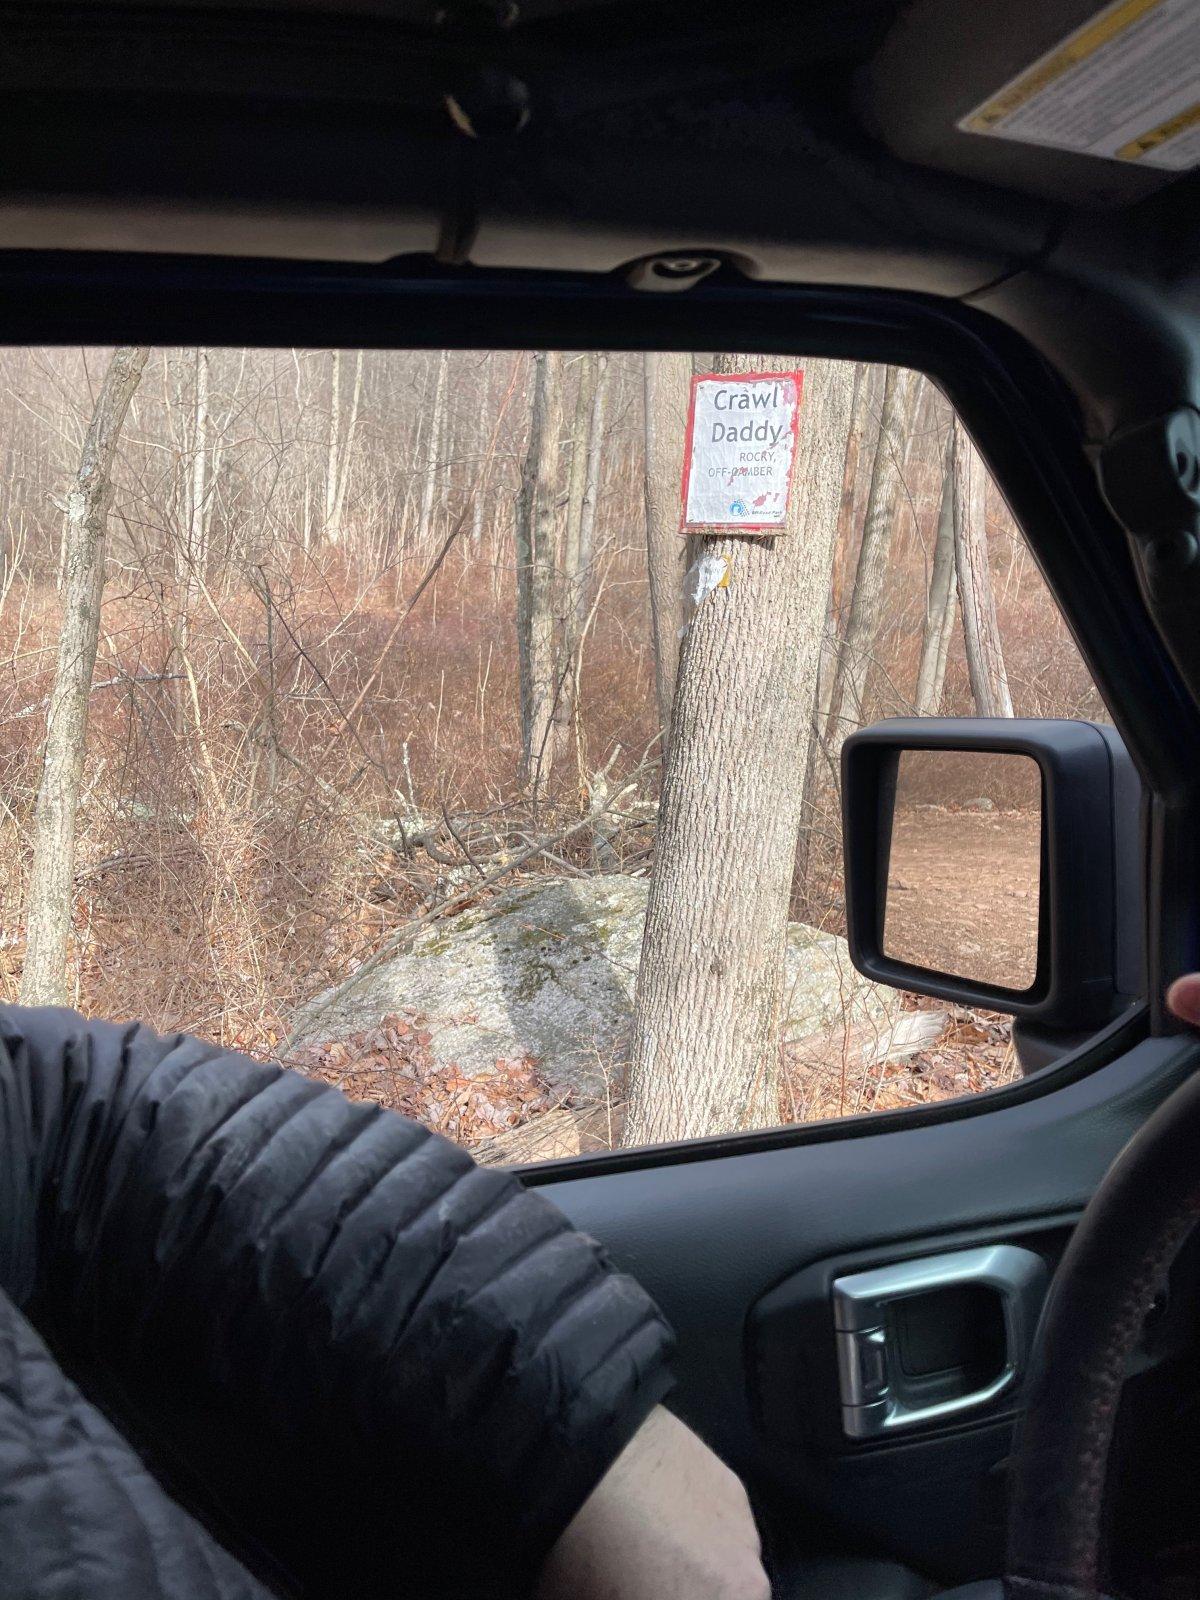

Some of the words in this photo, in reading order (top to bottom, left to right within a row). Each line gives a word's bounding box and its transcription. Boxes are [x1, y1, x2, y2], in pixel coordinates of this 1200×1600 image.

[714, 387, 778, 410] Crawl
[711, 420, 783, 447] Daddy
[739, 452, 776, 463] ROCKY,
